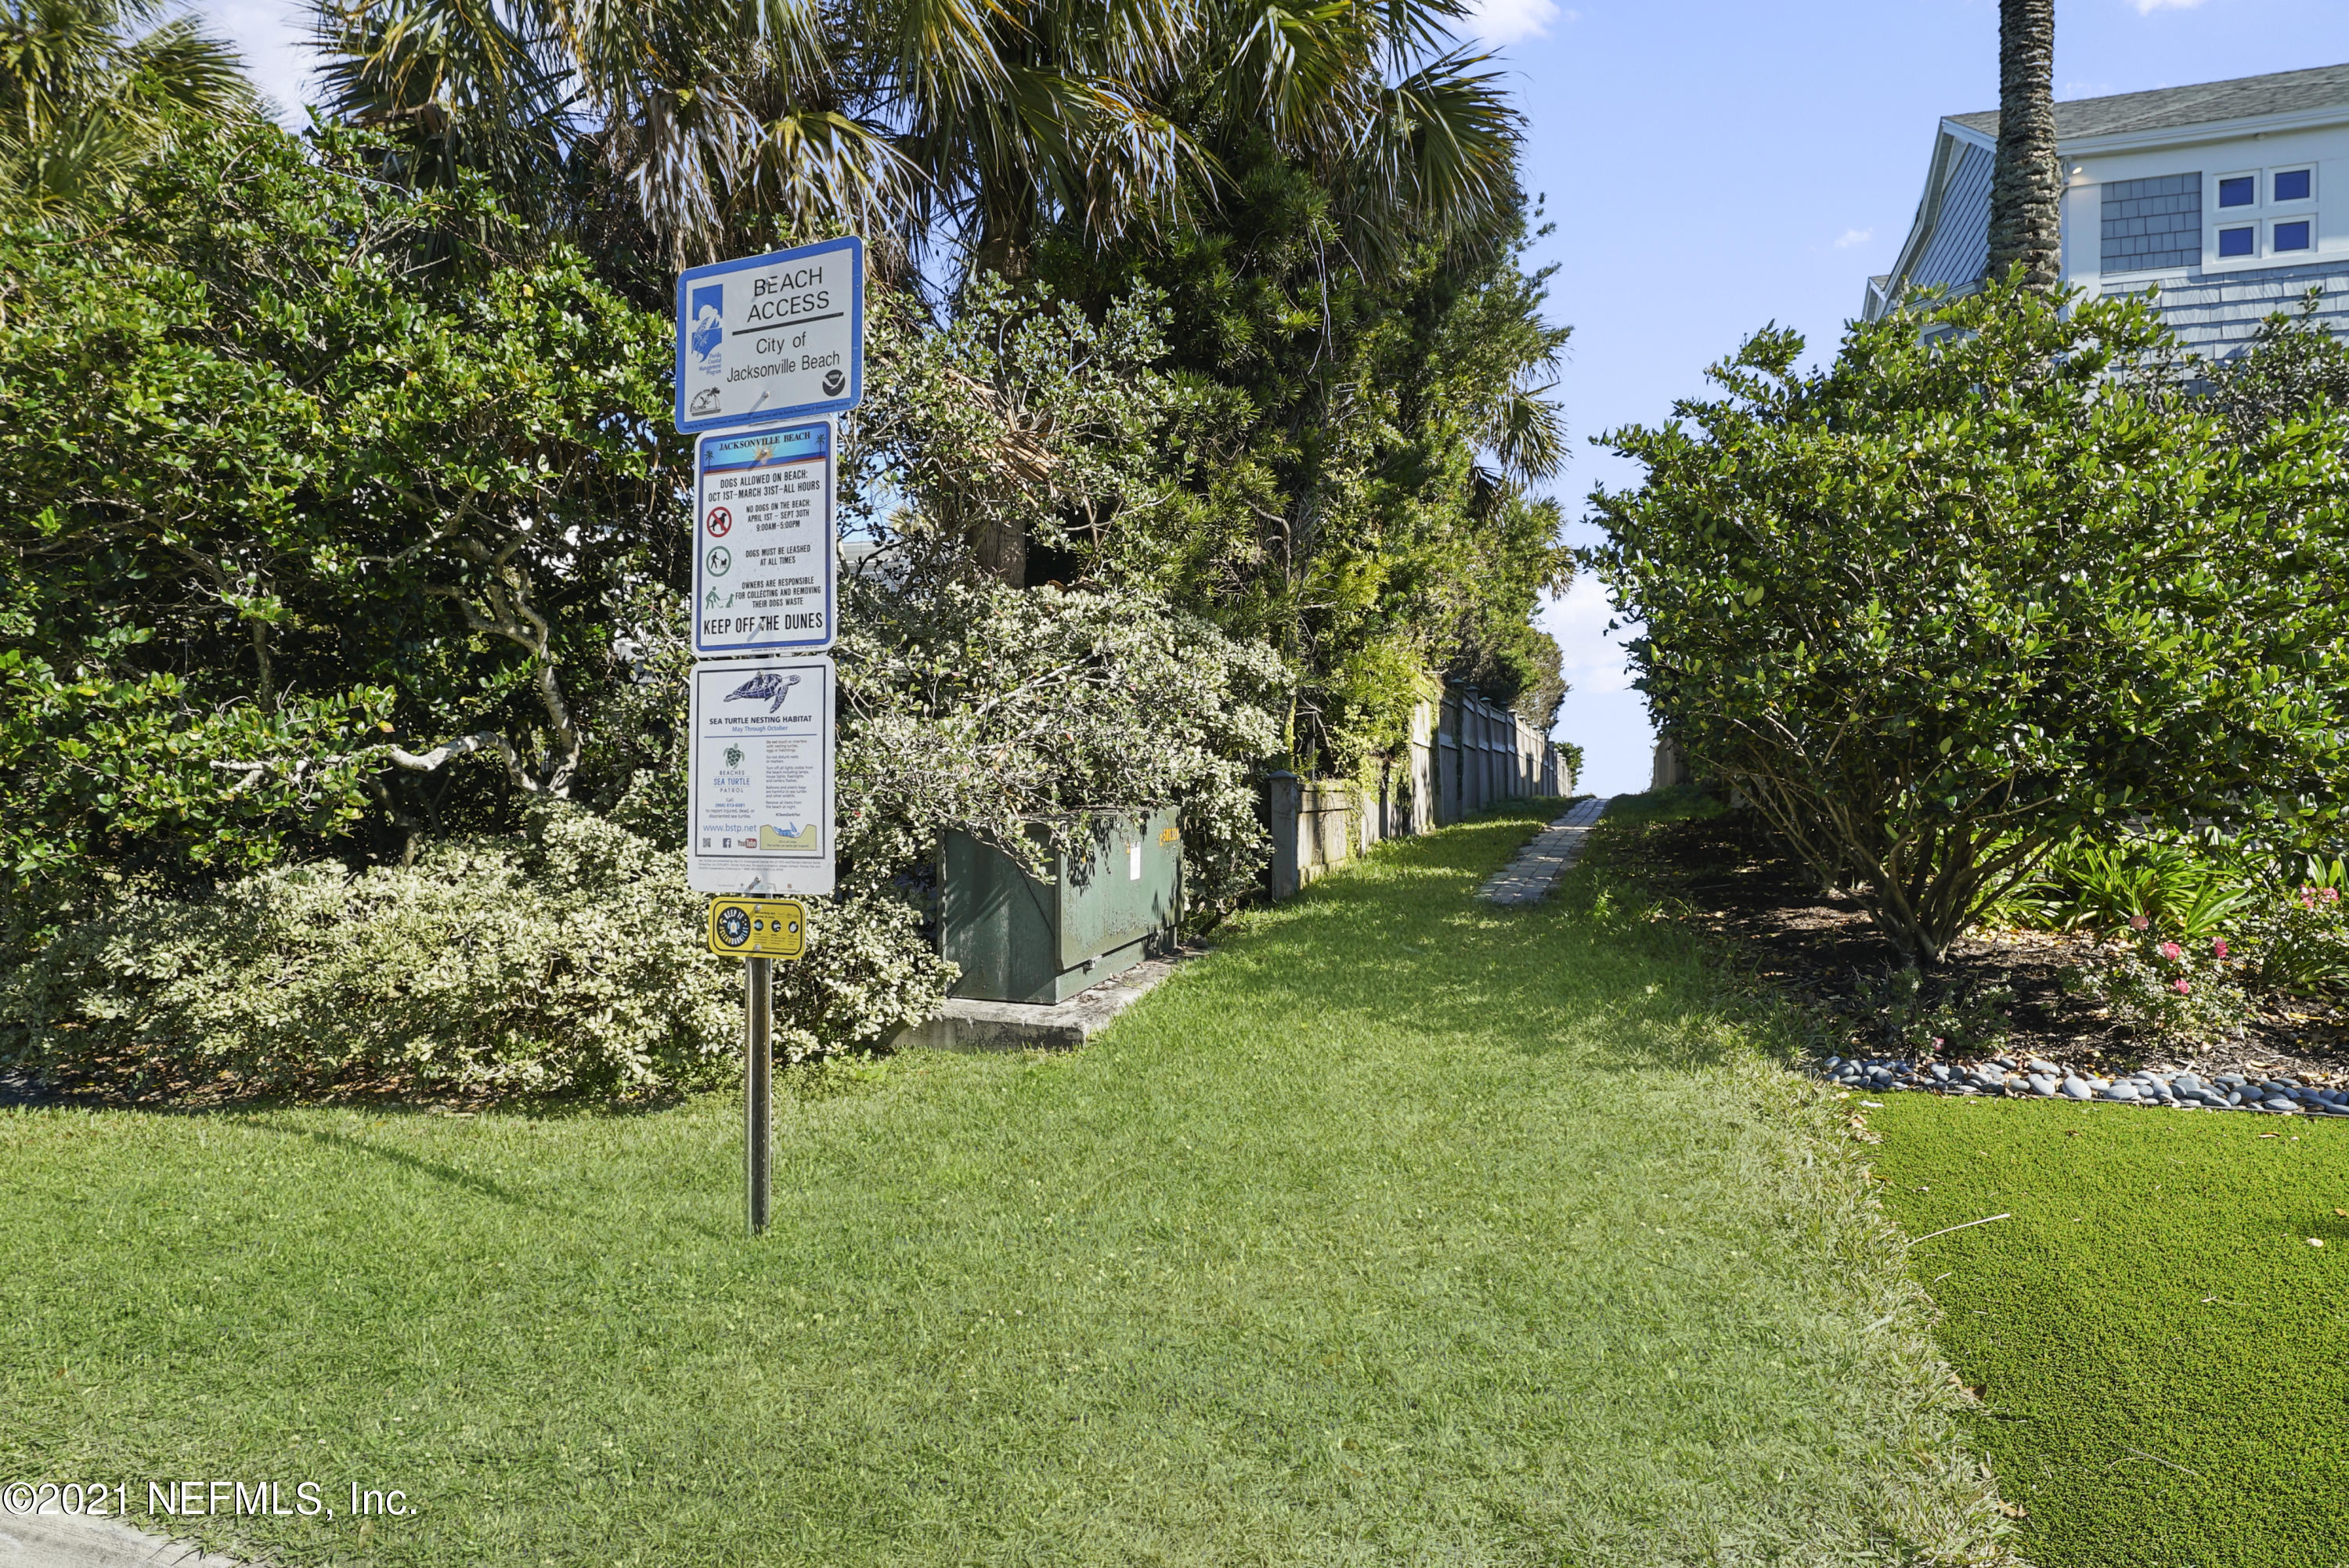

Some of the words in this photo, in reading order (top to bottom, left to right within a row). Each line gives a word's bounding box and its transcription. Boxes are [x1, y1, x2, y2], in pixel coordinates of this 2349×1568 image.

[754, 267, 822, 297] BEACH
[747, 291, 829, 323] ACCESS
[756, 338, 785, 355] City
[792, 332, 806, 348] of
[727, 359, 796, 382] Jacksonville
[802, 351, 839, 370] Beach
[719, 435, 780, 451] JACKSONVILLE
[784, 431, 810, 442] BEACH
[720, 478, 738, 488] DOGS
[740, 475, 770, 486] ALLOWED
[773, 474, 781, 482] ON
[785, 470, 808, 481] BEACH:
[709, 492, 720, 503] OCT
[798, 481, 820, 491] HOURS
[748, 514, 762, 522] APRIL
[781, 510, 794, 519] SEPT
[796, 509, 810, 517] 30TH
[745, 550, 760, 558] DOGS
[762, 547, 776, 557] MUST
[778, 546, 785, 555] BE
[786, 544, 810, 554] LEASHED
[779, 556, 796, 564] TIMES
[742, 579, 763, 589] OWNERS
[766, 579, 776, 587] ARE
[778, 576, 814, 586] RESPONSIBLE
[735, 592, 745, 600] FOR
[747, 589, 778, 599] COLLECTING
[780, 588, 791, 597] AND
[793, 586, 821, 596] REMOVING
[752, 600, 767, 608] THEIR
[769, 599, 783, 607] DOGS
[785, 597, 803, 606] WASTE
[704, 618, 731, 635] KEEP
[736, 617, 755, 633] OFF
[760, 615, 780, 631] THE
[785, 612, 822, 629] DUNES
[702, 824, 757, 833] www.bstp.net
[723, 910, 737, 919] KEEP
